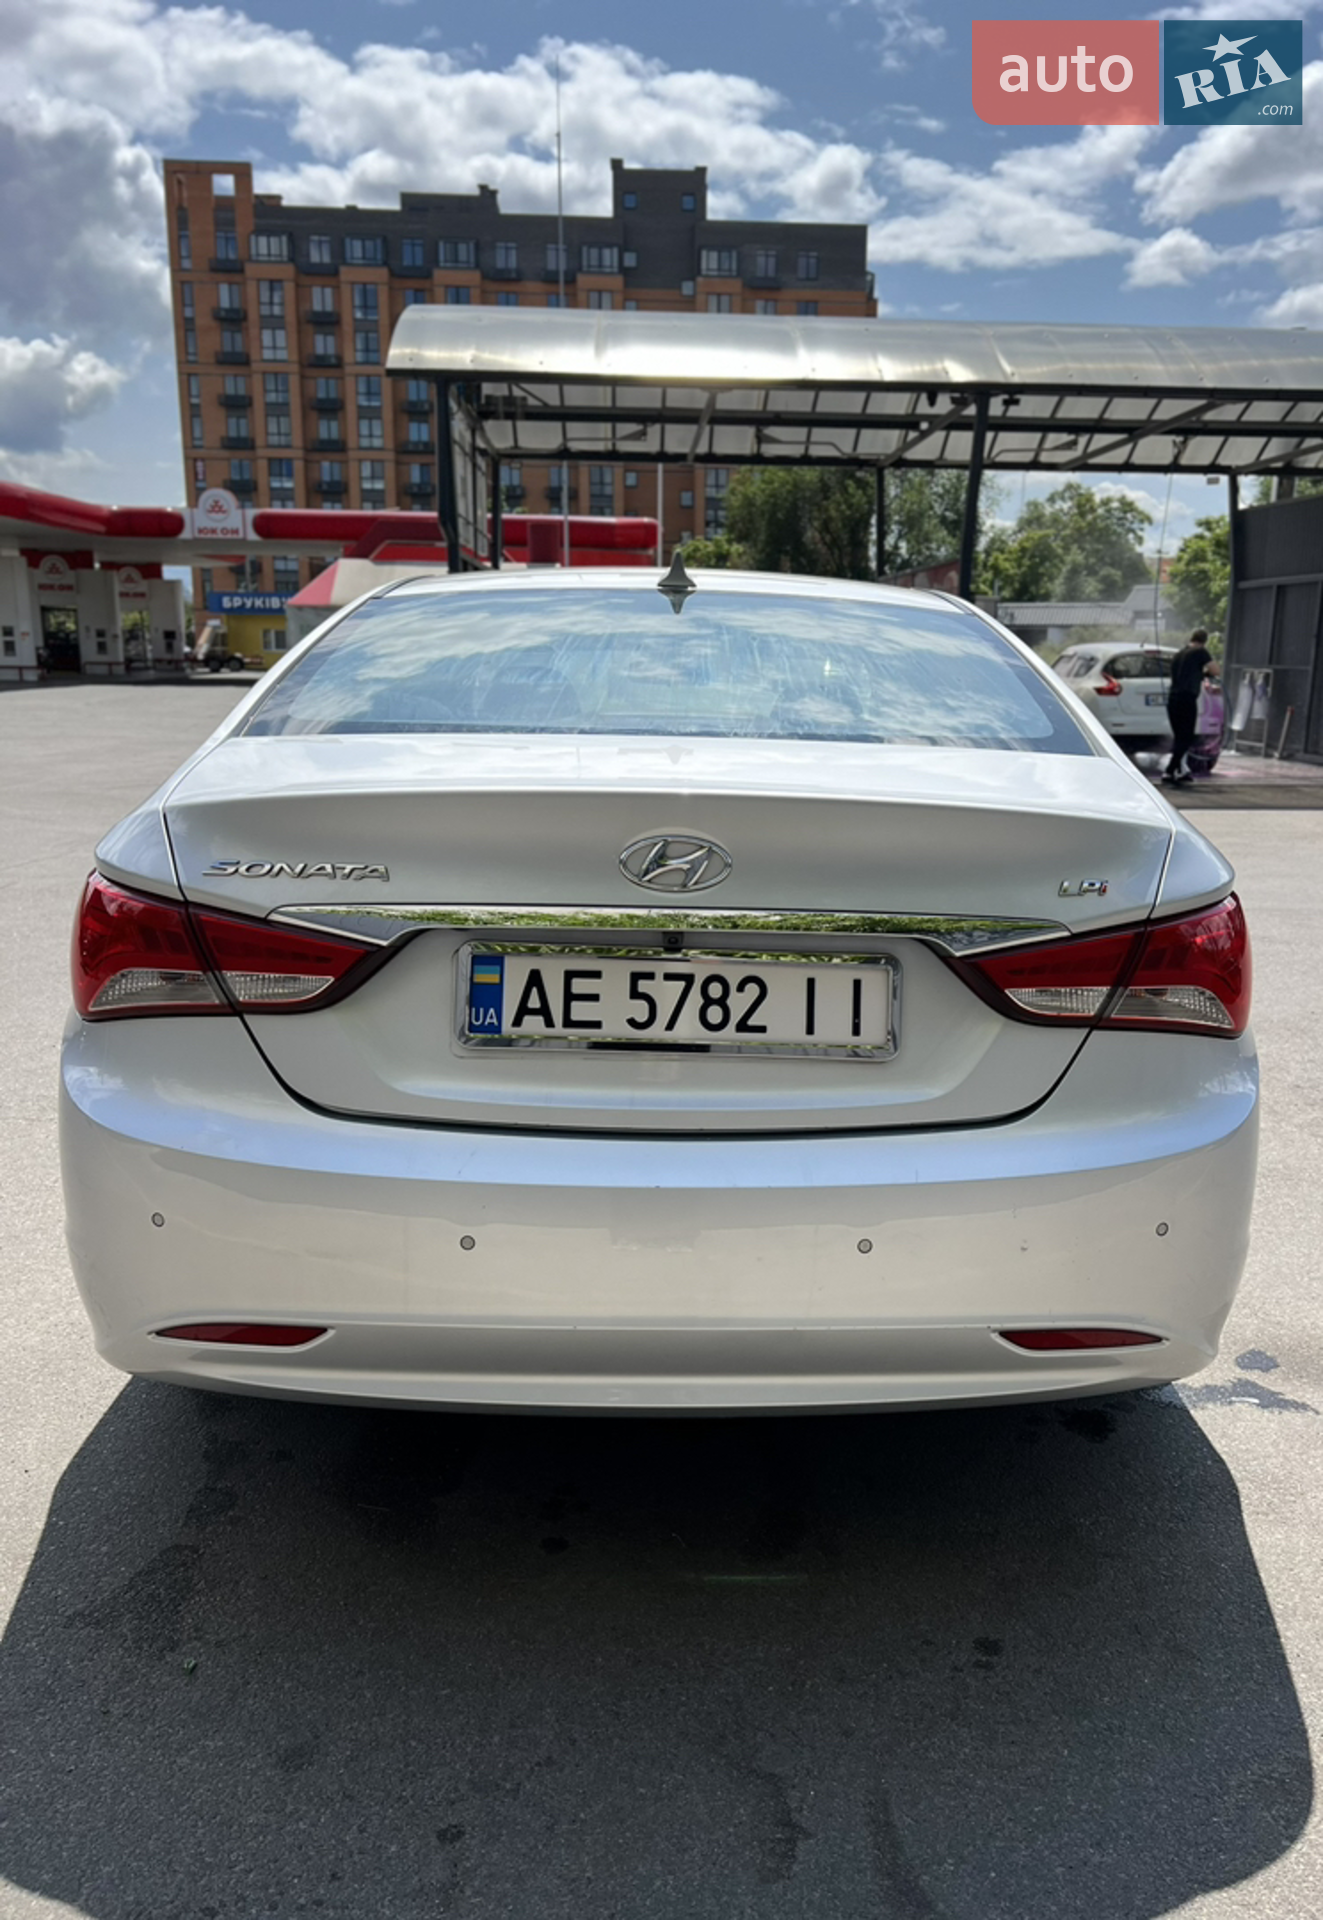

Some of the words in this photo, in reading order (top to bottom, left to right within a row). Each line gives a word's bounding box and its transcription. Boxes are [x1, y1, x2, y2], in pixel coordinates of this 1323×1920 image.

[202, 860, 390, 882] SONATA
[511, 969, 602, 1030] AE
[626, 971, 768, 1033] 5782
[471, 1007, 499, 1026] UA
